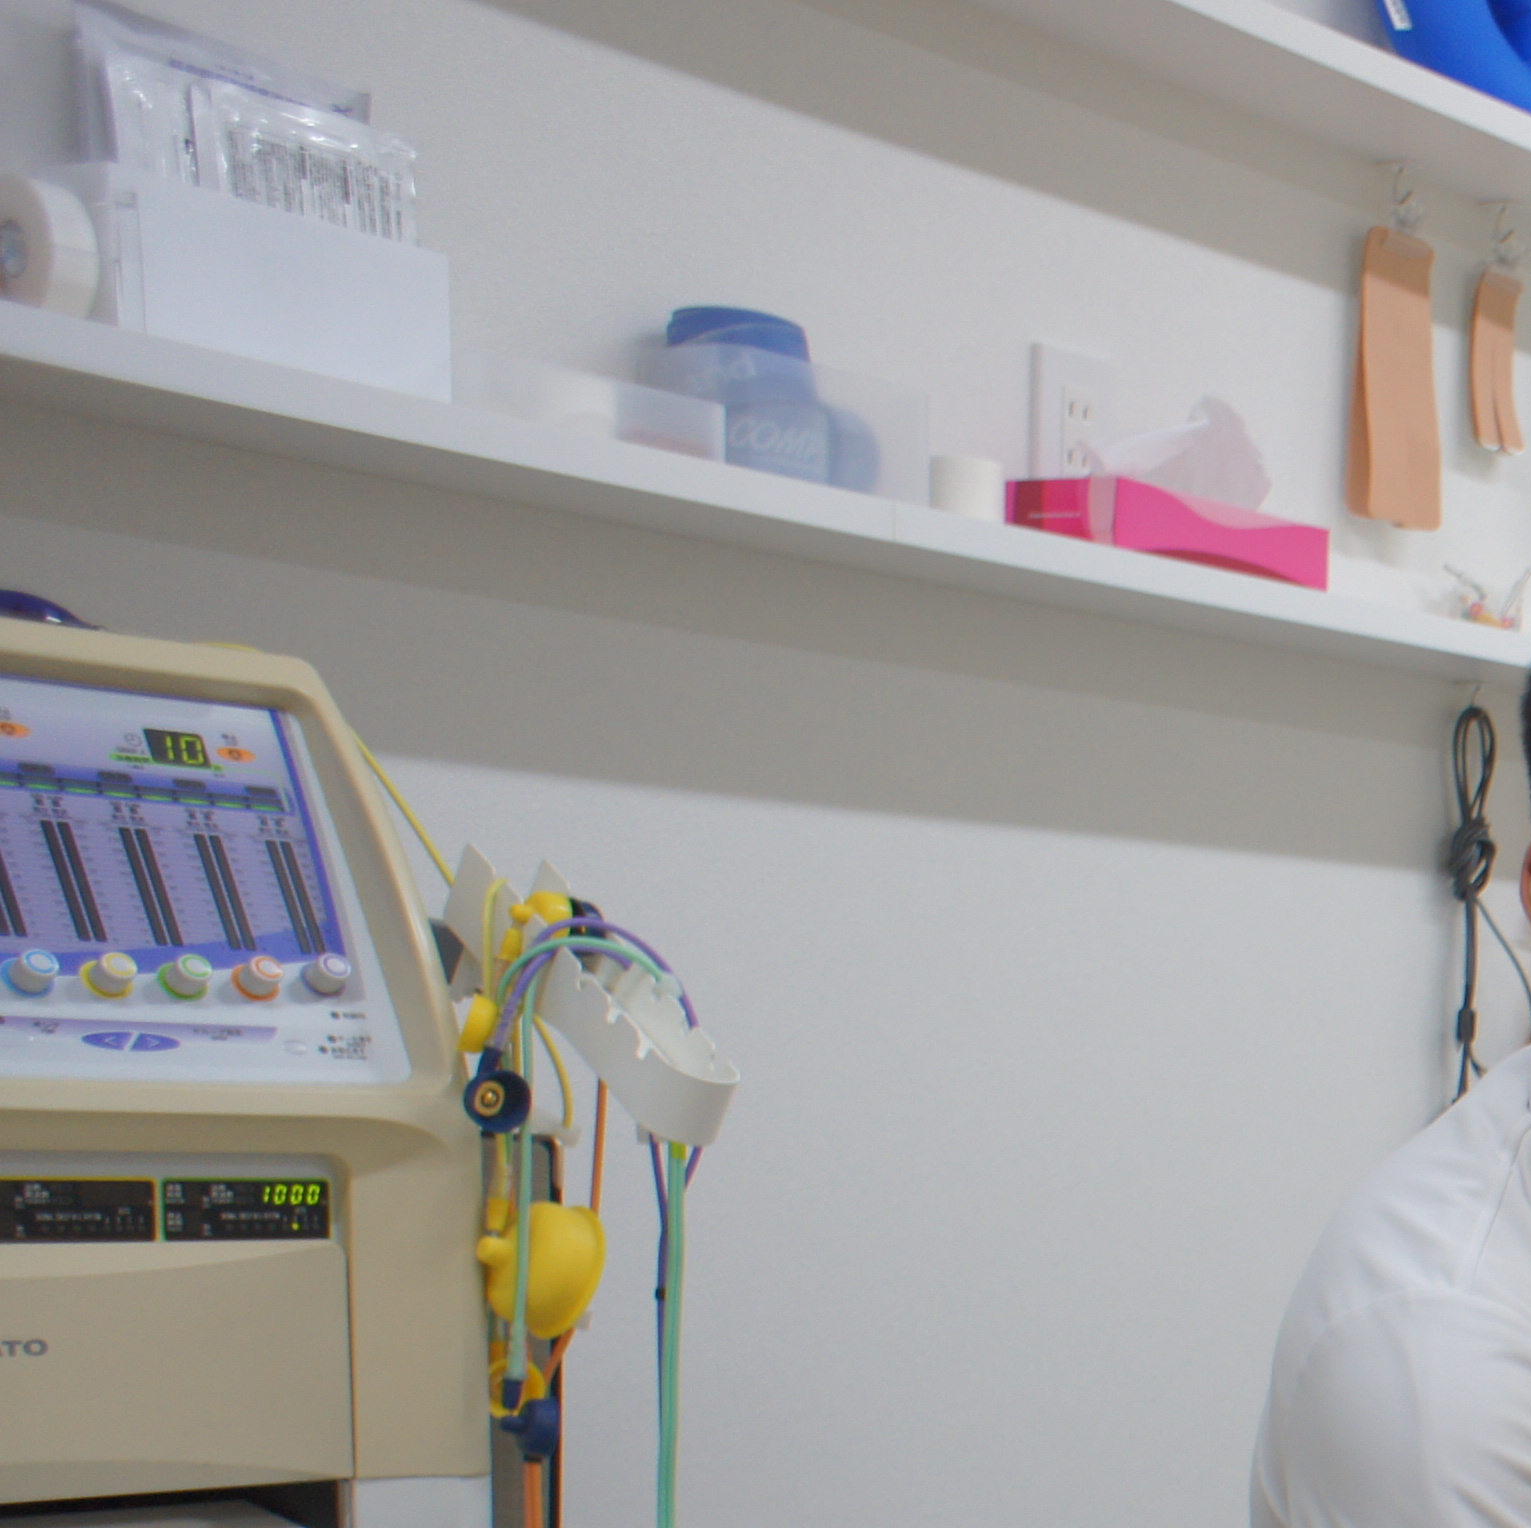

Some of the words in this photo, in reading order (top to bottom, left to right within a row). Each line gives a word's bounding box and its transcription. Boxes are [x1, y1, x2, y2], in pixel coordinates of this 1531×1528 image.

[165, 735, 205, 765] 10
[263, 1184, 321, 1206] 1000
[0, 1339, 48, 1357] TO
